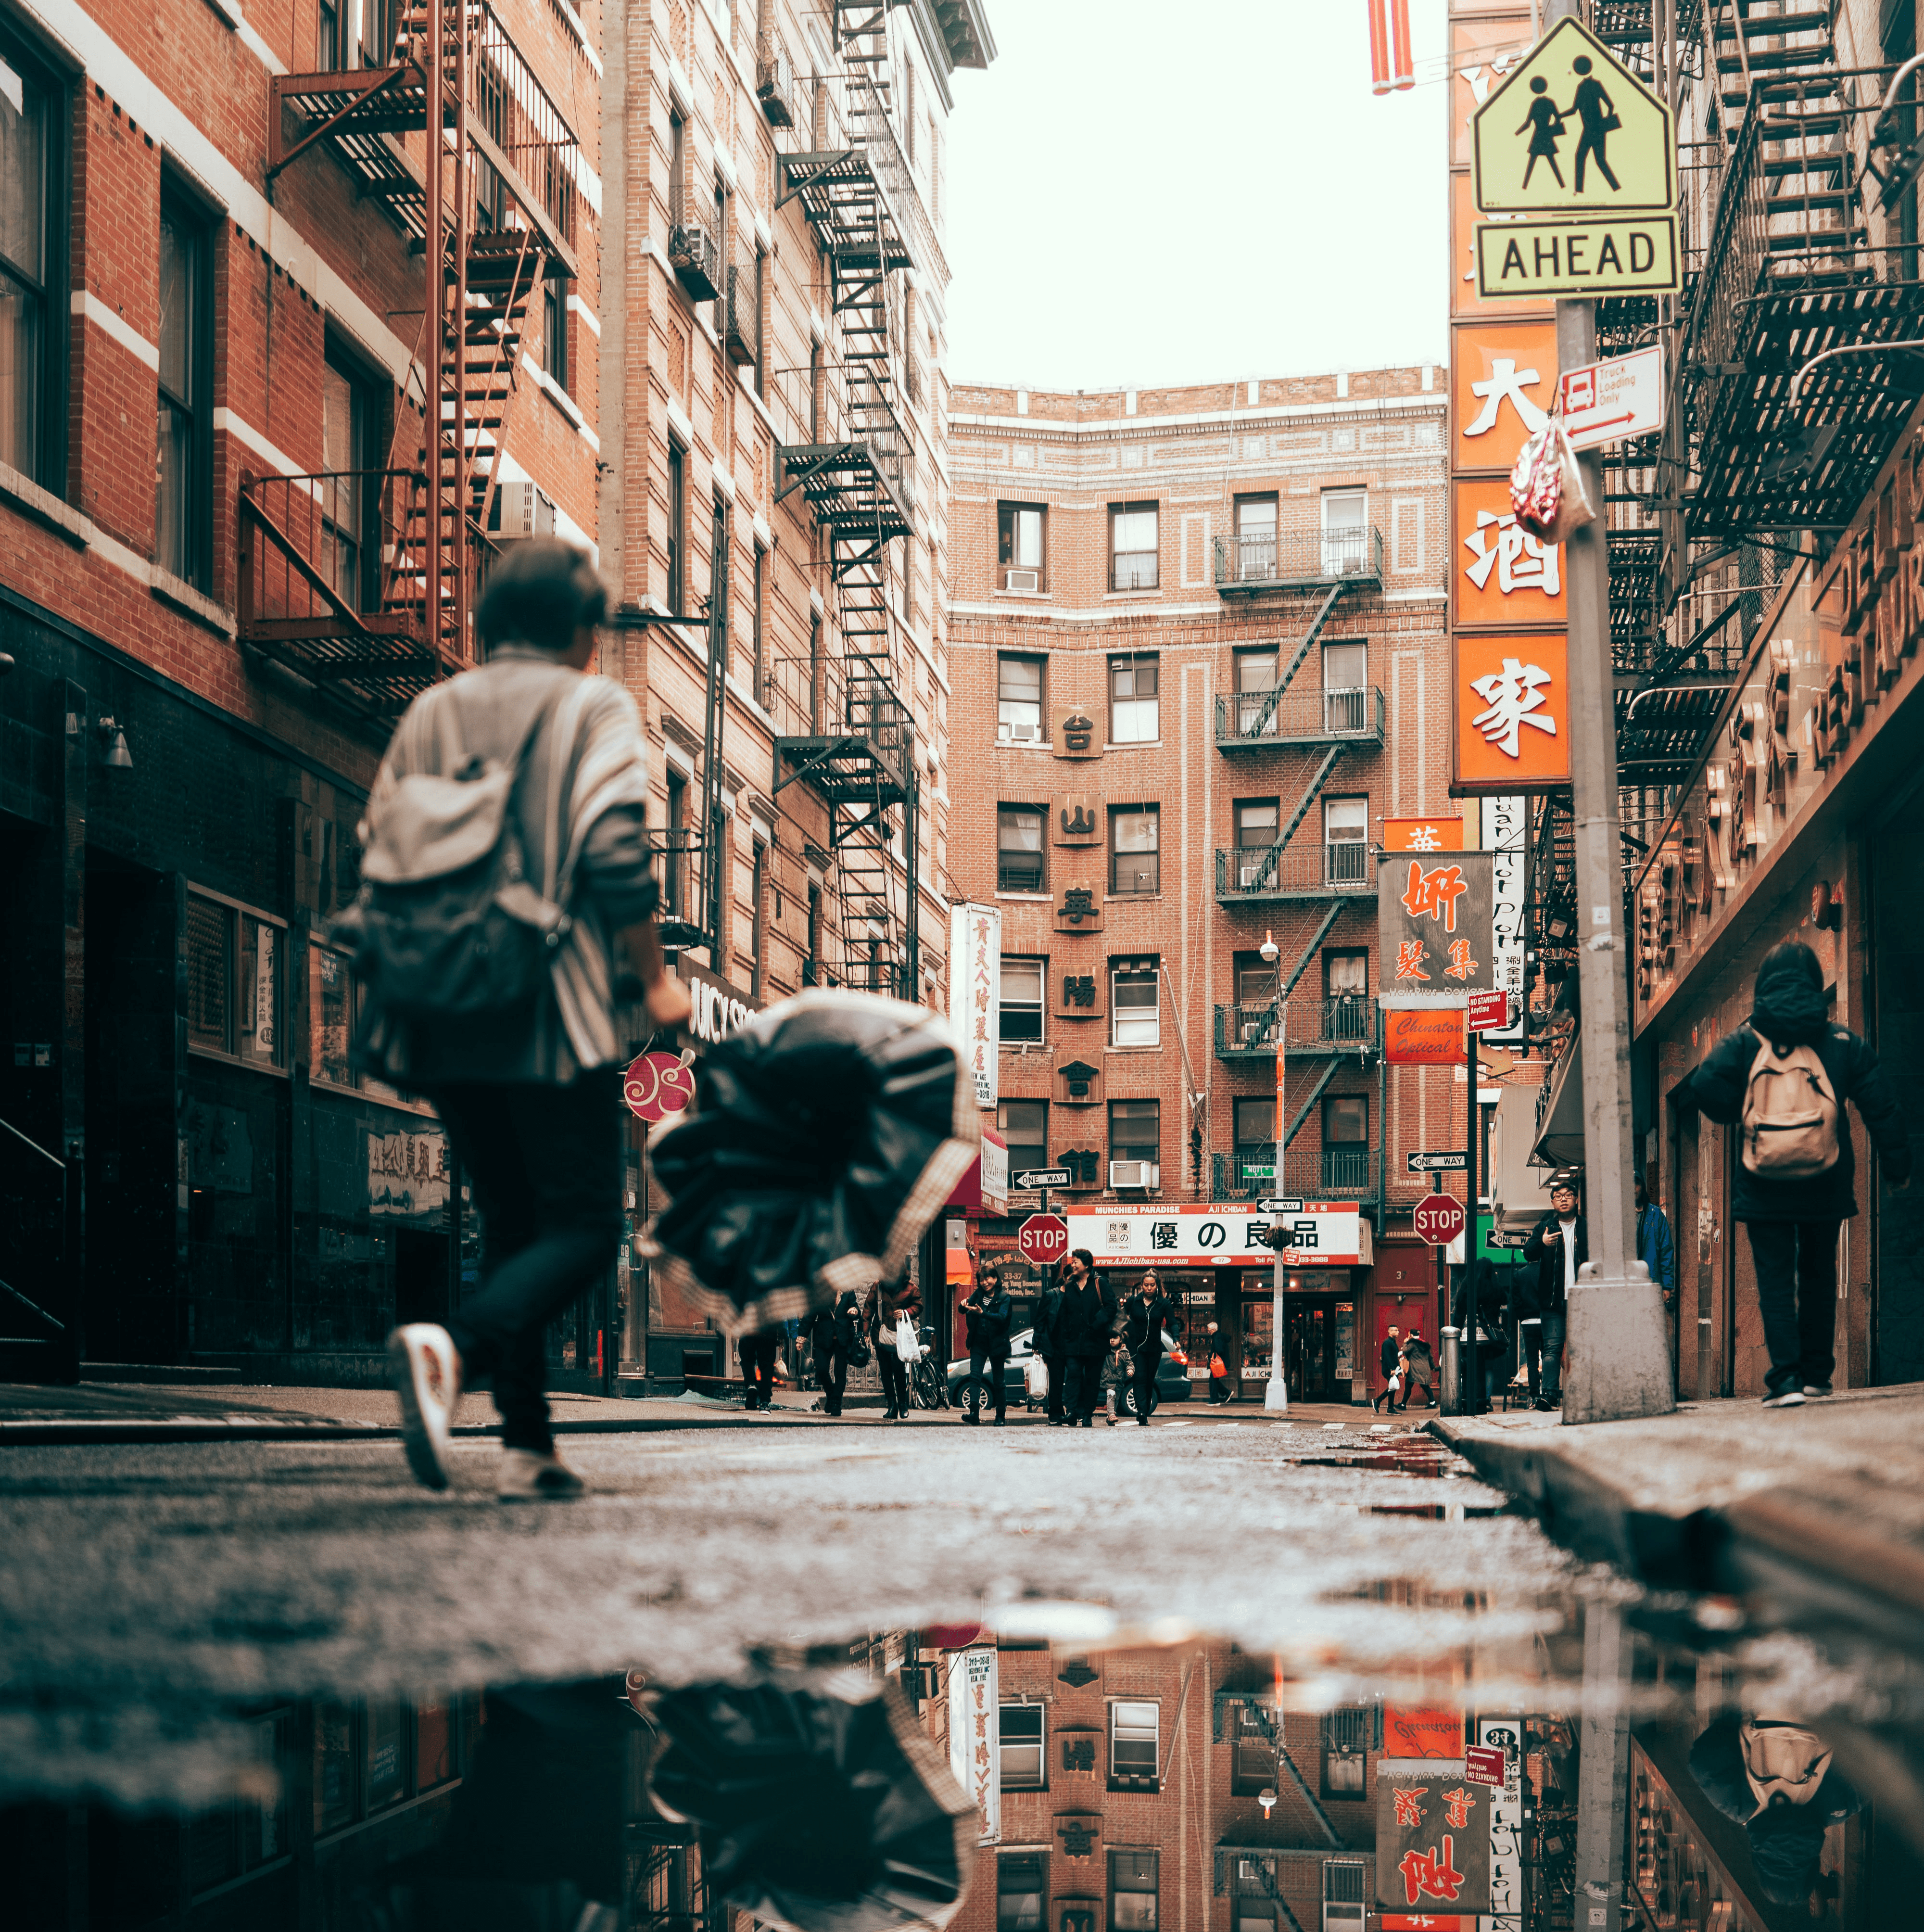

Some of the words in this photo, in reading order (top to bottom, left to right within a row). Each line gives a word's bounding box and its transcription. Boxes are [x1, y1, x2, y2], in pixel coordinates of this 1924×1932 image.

[1501, 232, 1655, 279] AHEAD
[1600, 364, 1626, 379] Truck
[1599, 374, 1635, 393] Loading
[1599, 392, 1620, 406] Only
[1493, 847, 1514, 894] Hot
[1444, 987, 1485, 996] Design
[1478, 994, 1501, 1005] STANDING
[1470, 1005, 1490, 1015] Anytime
[1396, 1039, 1451, 1056] Optical
[1418, 1210, 1461, 1229] STOP
[1023, 1230, 1066, 1248] STOP
